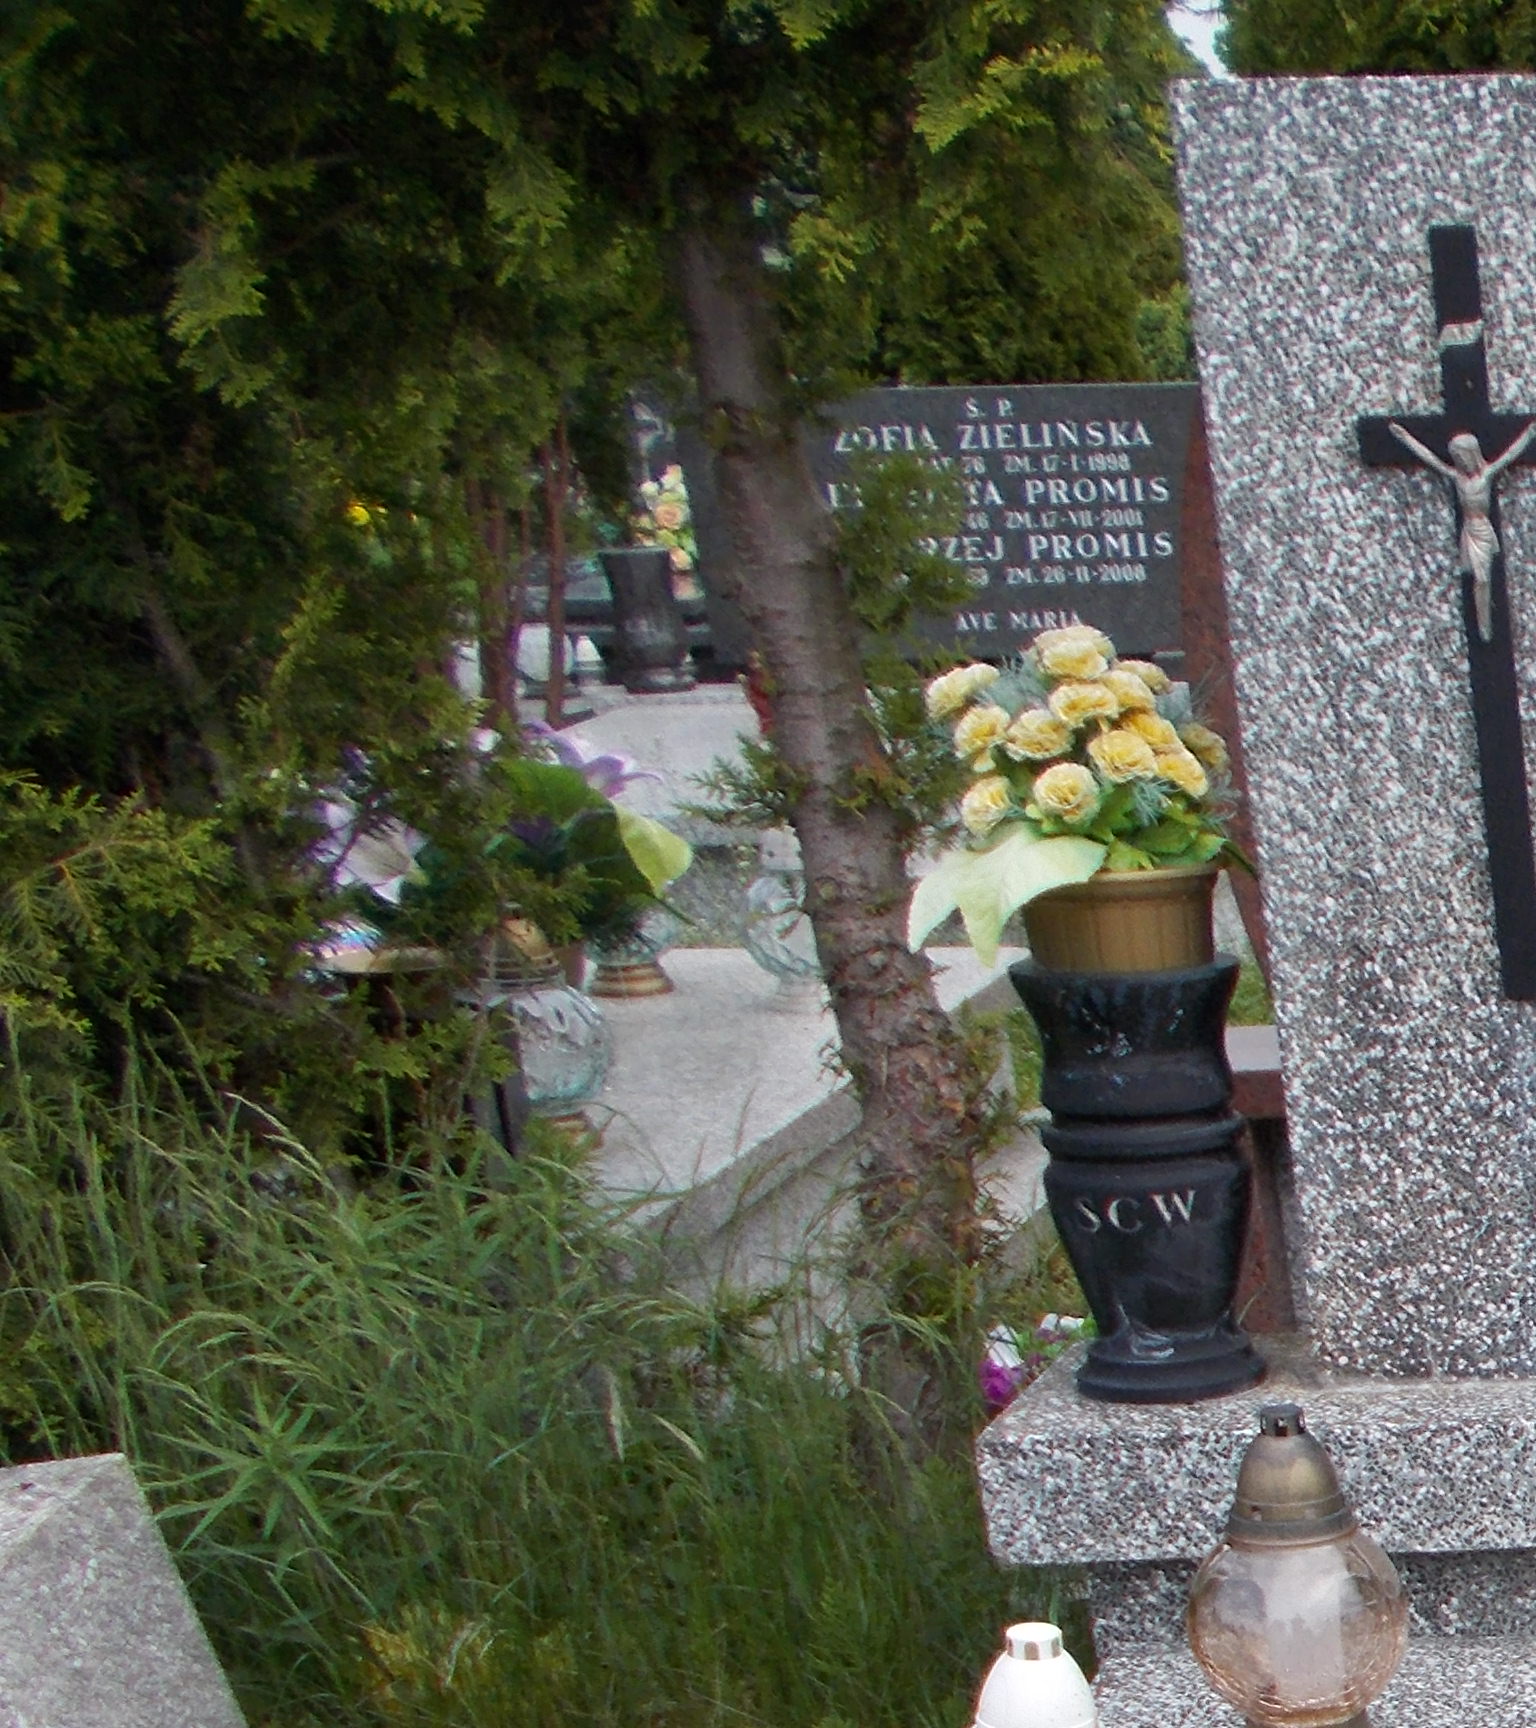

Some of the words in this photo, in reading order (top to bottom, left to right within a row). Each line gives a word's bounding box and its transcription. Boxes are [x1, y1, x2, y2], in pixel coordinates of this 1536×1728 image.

[833, 423, 939, 452] ZOFIA
[1024, 476, 1170, 504] PROMIS
[1027, 532, 1173, 560] PROMIS
[955, 611, 997, 631] AVE
[1008, 608, 1082, 631] MARIA
